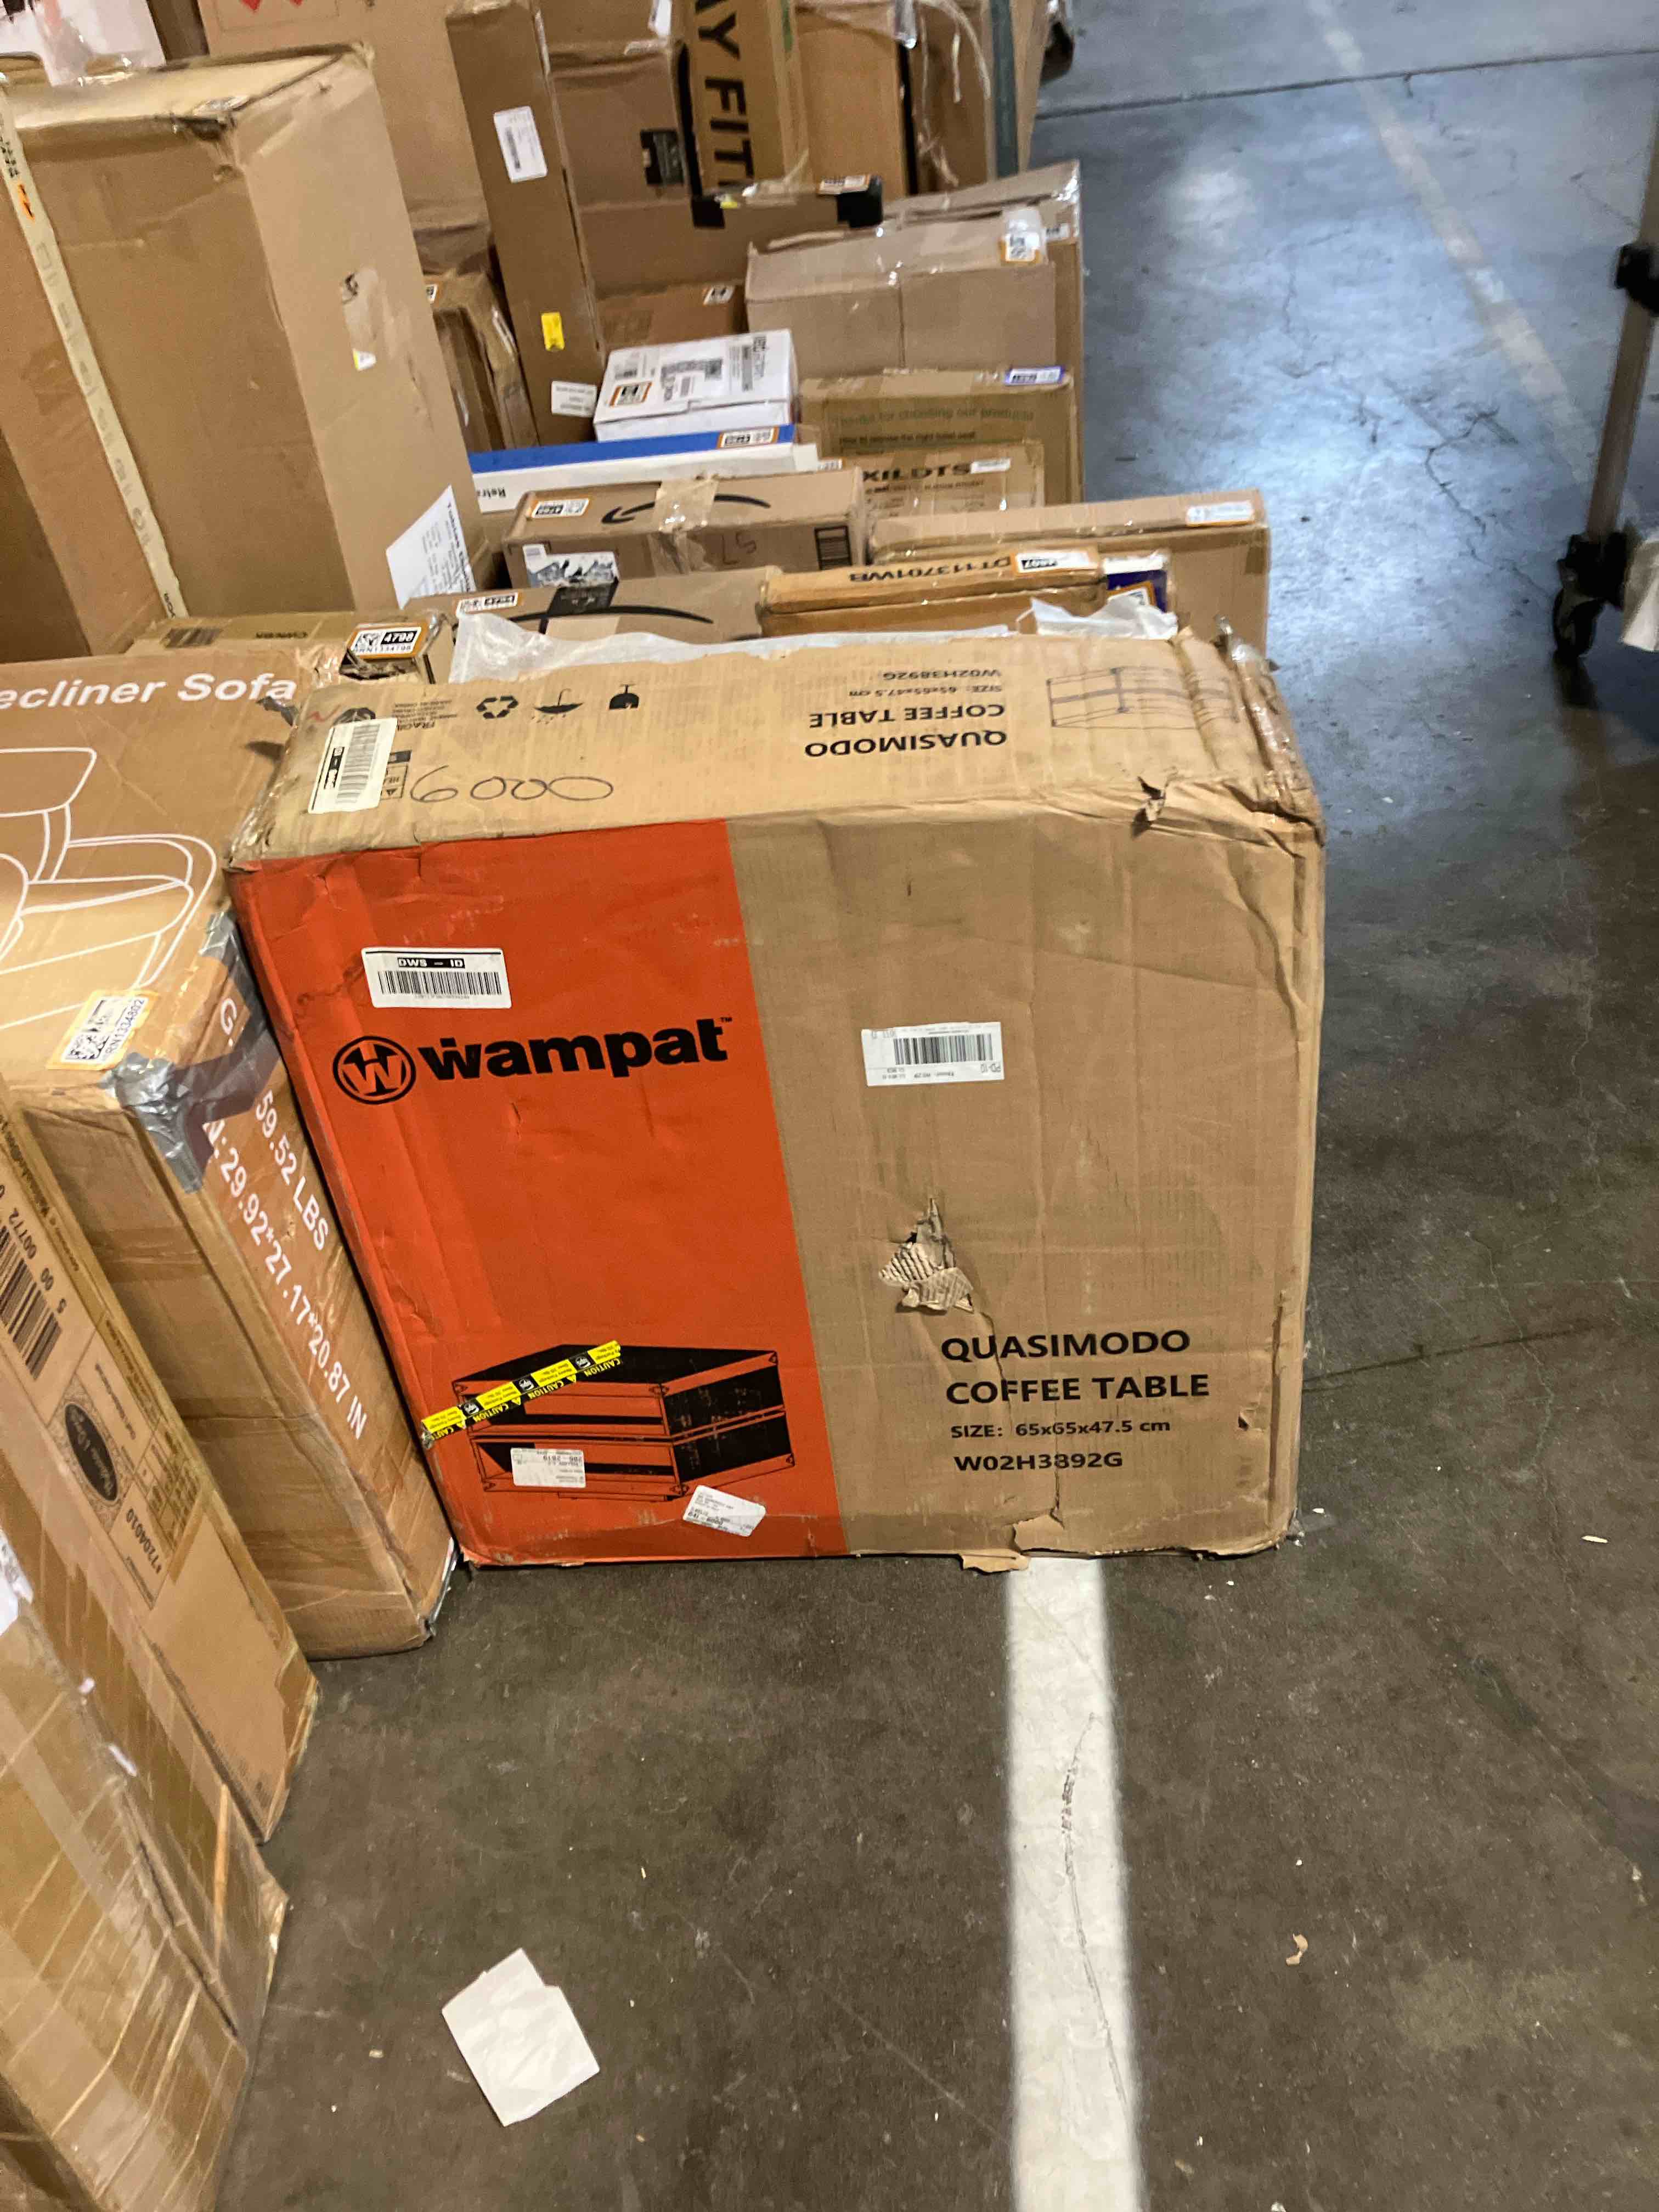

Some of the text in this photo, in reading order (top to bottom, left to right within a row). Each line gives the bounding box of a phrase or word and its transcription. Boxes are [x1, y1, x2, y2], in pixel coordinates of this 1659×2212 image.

[177, 672, 298, 704] Sofa
[809, 704, 1005, 729] COFFEE TABLE
[804, 730, 1007, 758] QUASIMODO
[450, 958, 464, 968] ID
[419, 1018, 728, 1081] wampat
[255, 1089, 329, 1251] 59.52 LBS
[941, 1329, 1191, 1363] QUASIMODO
[583, 1358, 621, 1377] CAUTION
[528, 1379, 565, 1400] CAUTION
[946, 1373, 1210, 1404] COFFEE TABLE
[346, 1395, 368, 1441] IN
[472, 1403, 510, 1423] CAUTION
[951, 1420, 1171, 1438] SIZE: 65x65x47.5 cm
[953, 1452, 1124, 1471] W02H3892G
